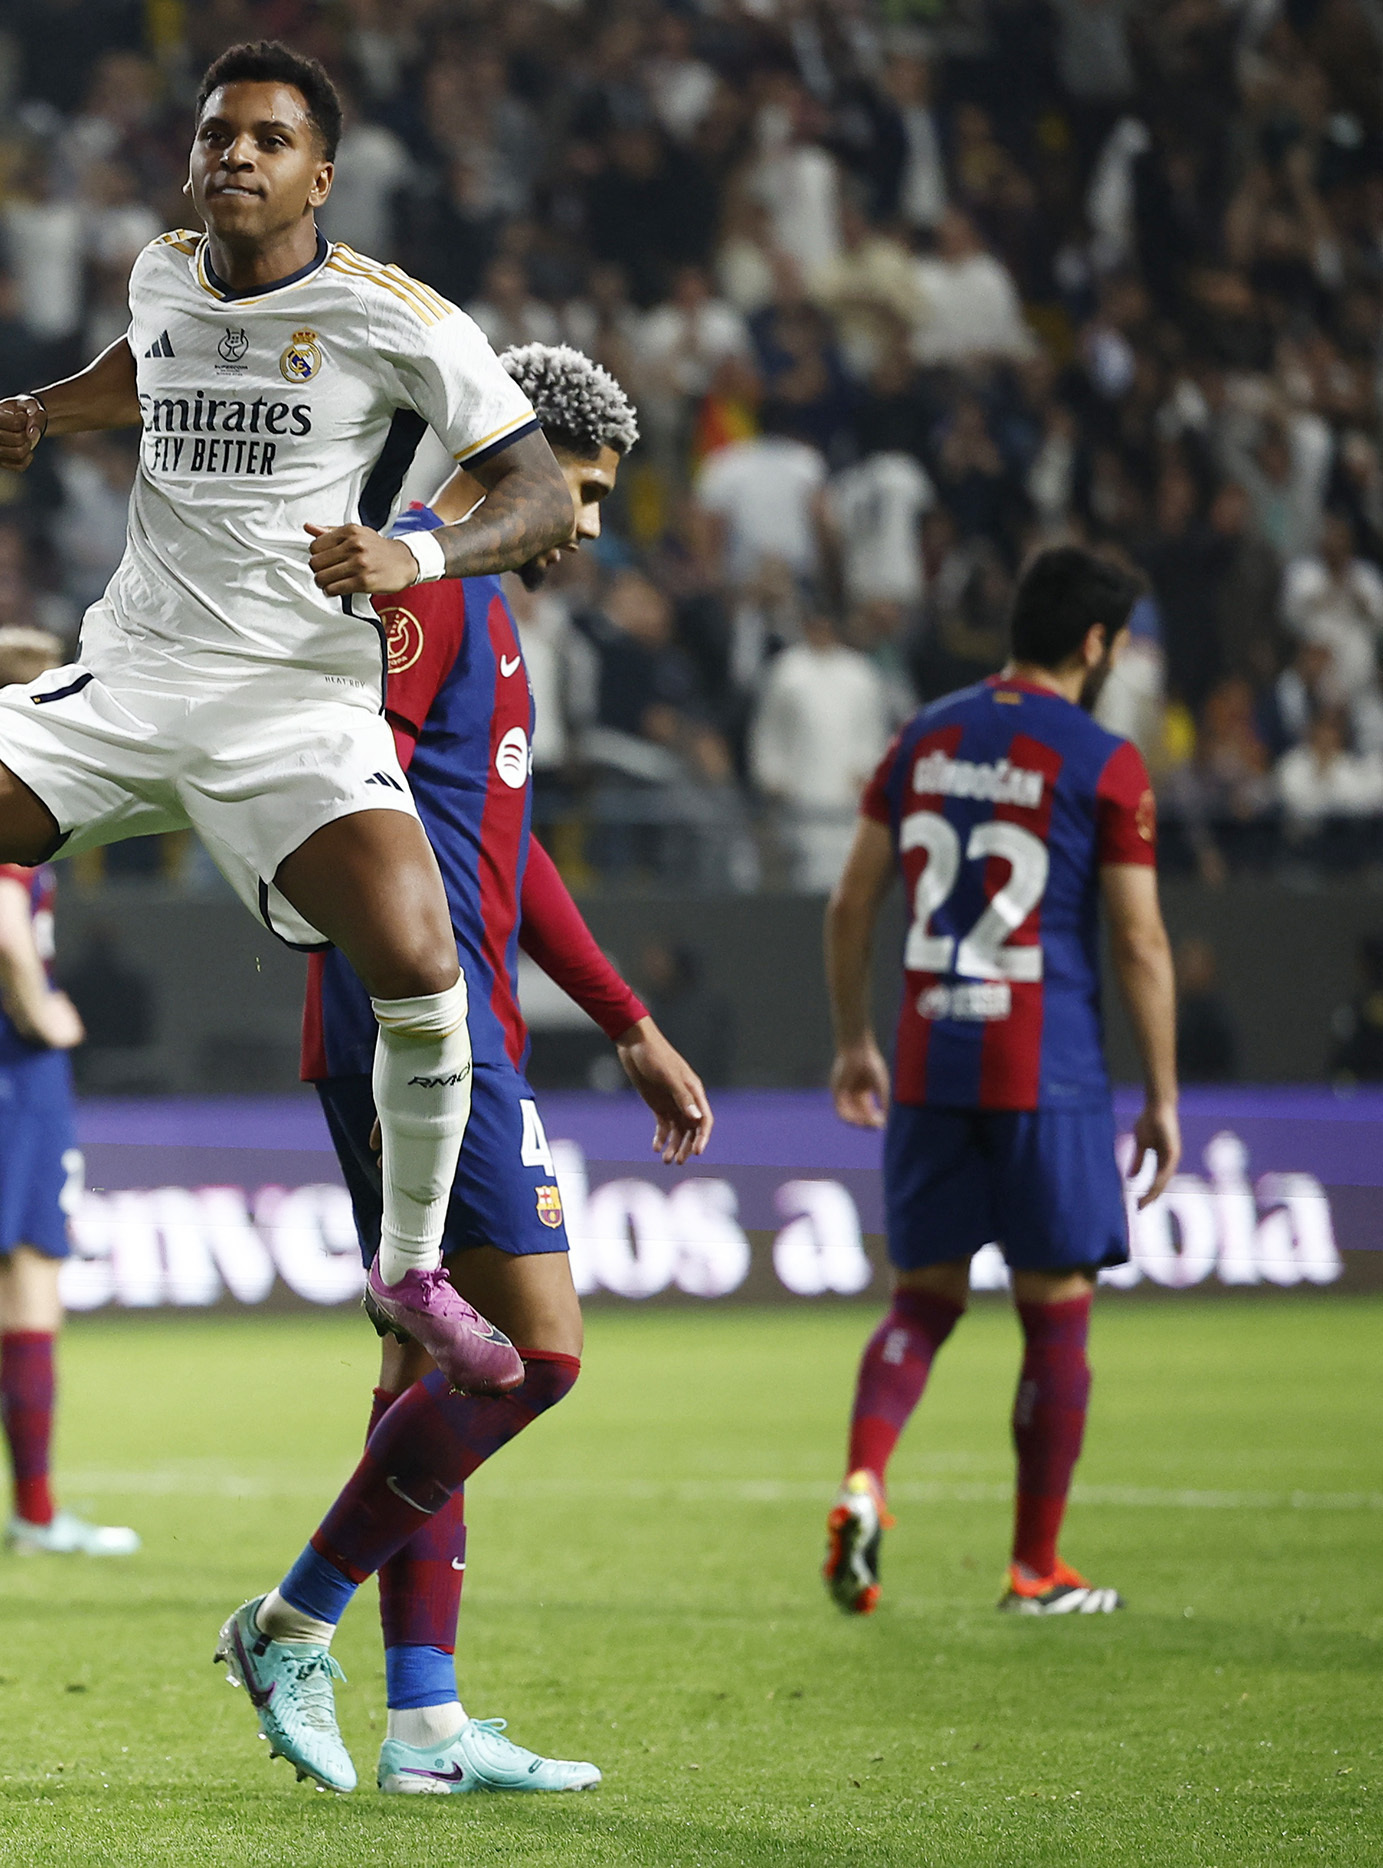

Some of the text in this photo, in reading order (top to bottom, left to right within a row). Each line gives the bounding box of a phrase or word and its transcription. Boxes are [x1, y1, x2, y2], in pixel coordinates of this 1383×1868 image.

[151, 437, 277, 476] FLY BETTER
[899, 809, 1050, 983] 22
[519, 1098, 556, 1178] 4
[773, 1178, 873, 1297] a
